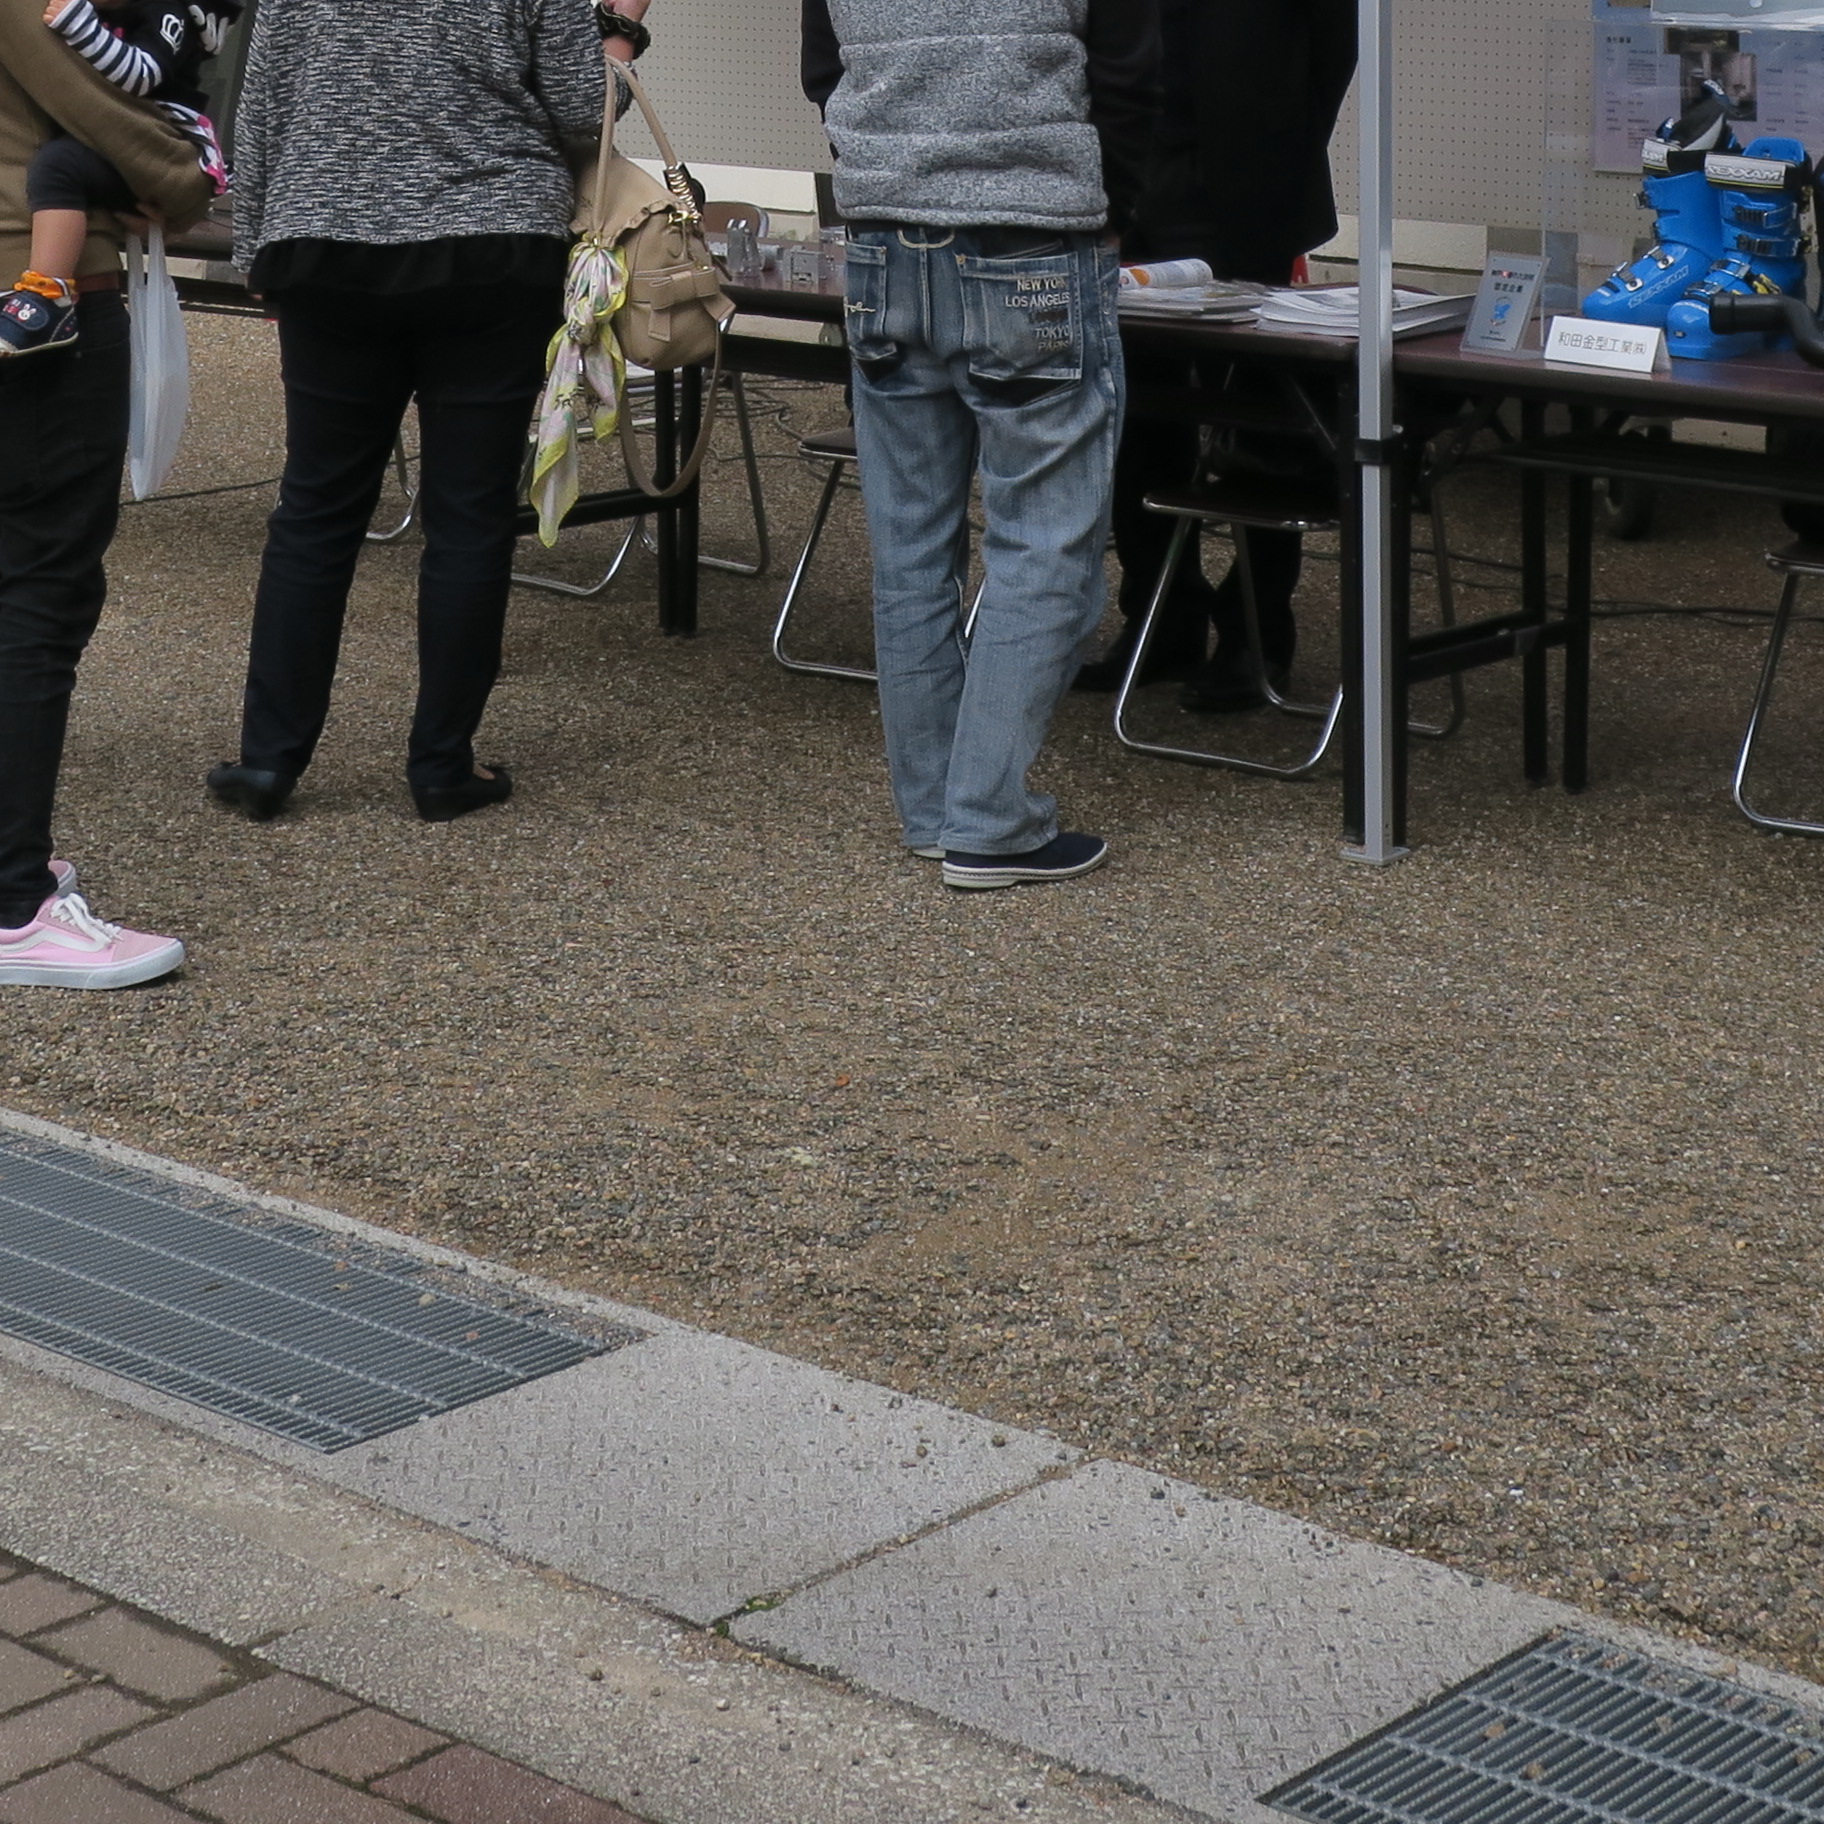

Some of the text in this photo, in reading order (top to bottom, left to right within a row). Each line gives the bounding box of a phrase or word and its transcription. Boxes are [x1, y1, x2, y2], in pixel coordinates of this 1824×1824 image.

[1017, 278, 1040, 292] NEW
[1005, 291, 1071, 308] LOS ANGELES
